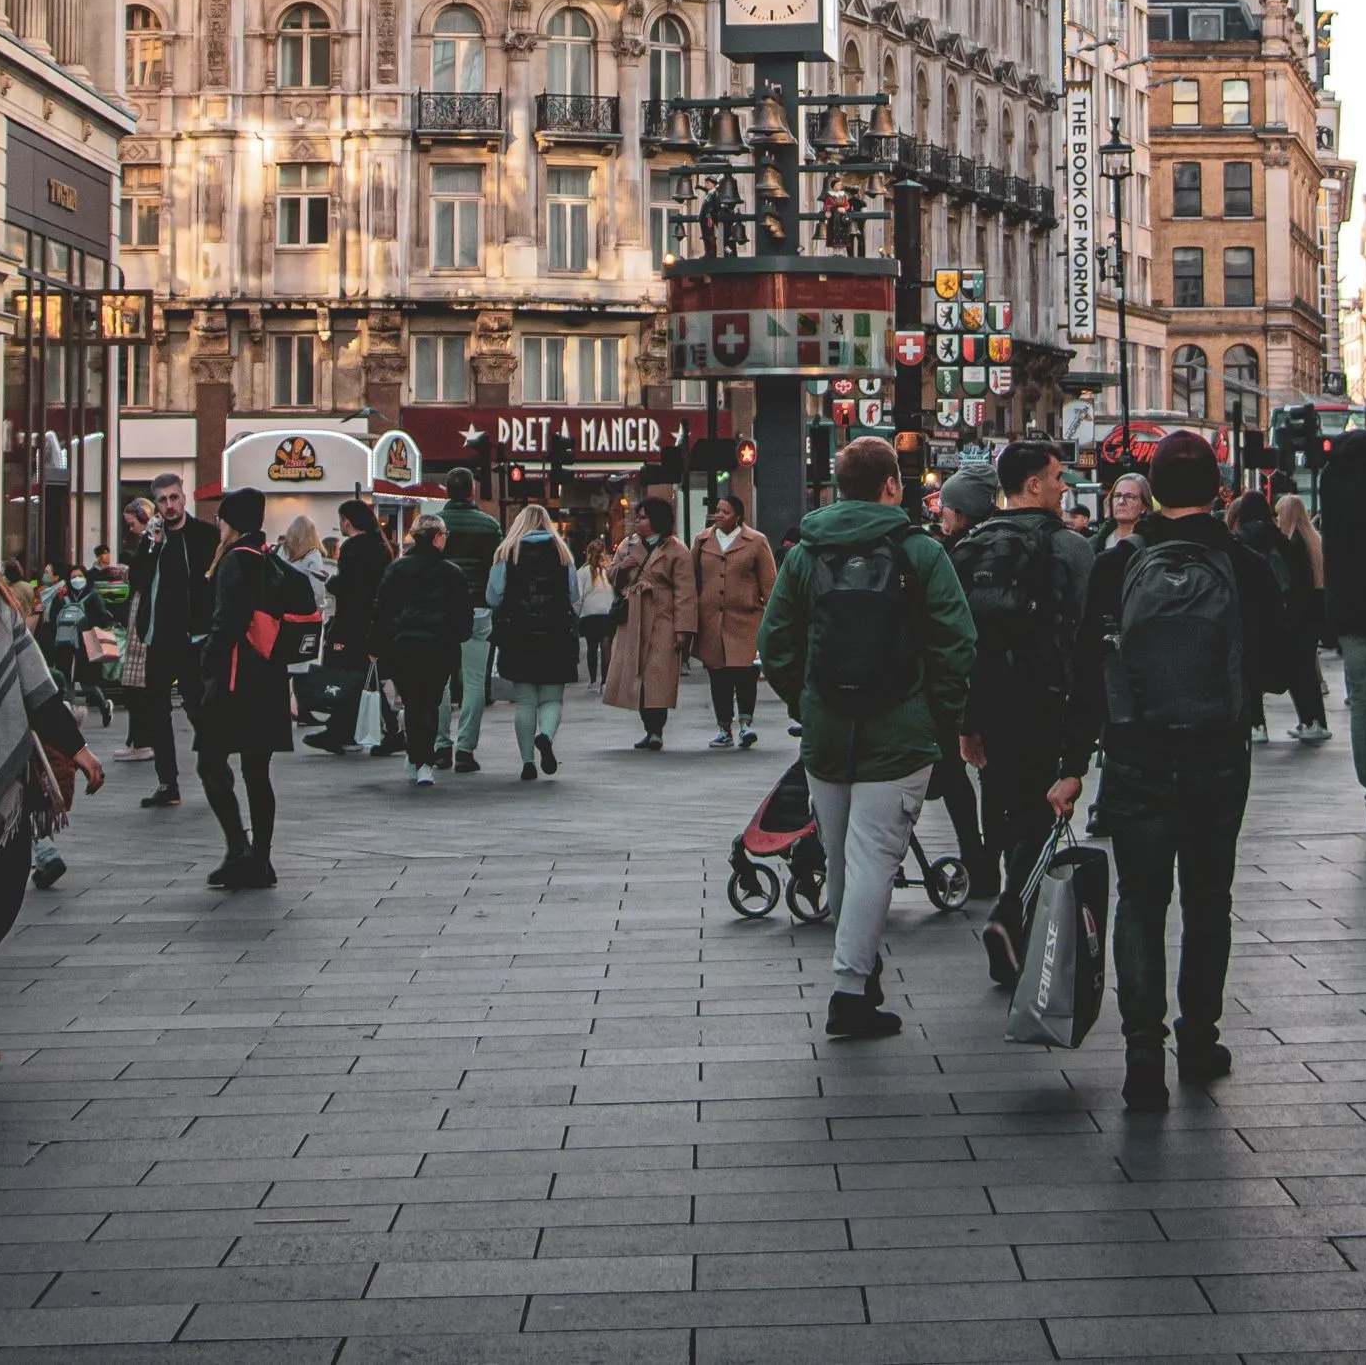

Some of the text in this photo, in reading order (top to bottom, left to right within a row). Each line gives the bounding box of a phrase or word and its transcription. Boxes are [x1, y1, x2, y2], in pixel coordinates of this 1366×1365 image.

[1072, 97, 1089, 328] THE BOOK OF MORMON
[498, 416, 551, 452] PRET
[580, 417, 661, 453] MANGER
[1037, 920, 1058, 1010] DAINESE
